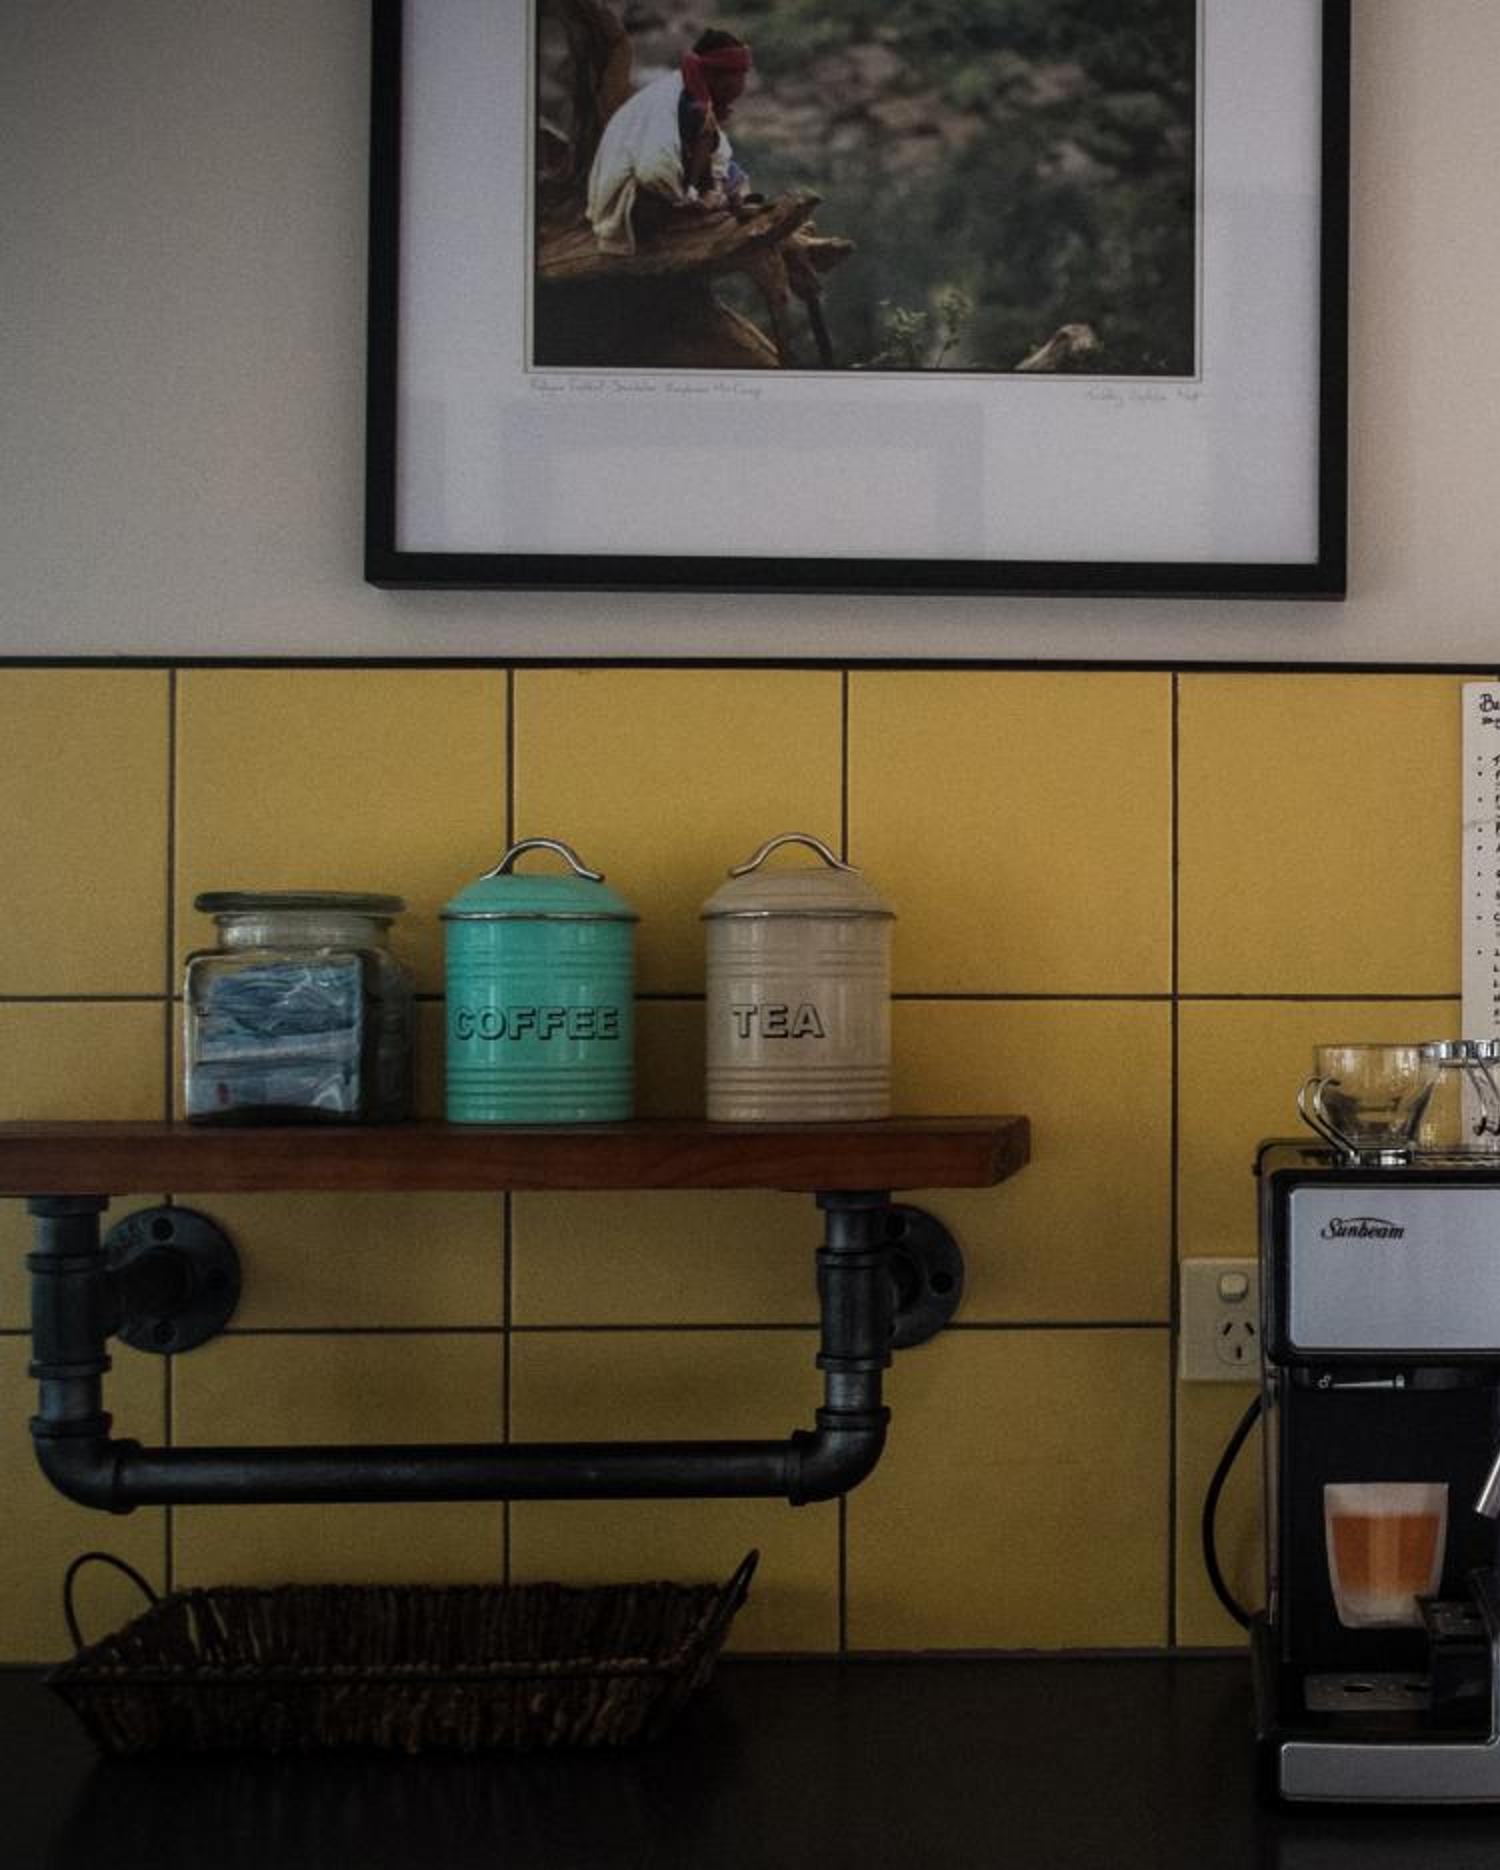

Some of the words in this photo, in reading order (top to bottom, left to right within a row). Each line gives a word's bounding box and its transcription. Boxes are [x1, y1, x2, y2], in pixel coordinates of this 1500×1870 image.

[454, 1003, 621, 1042] COFFEE
[732, 1003, 826, 1040] TEA
[1321, 1217, 1405, 1240] Sunbeam
